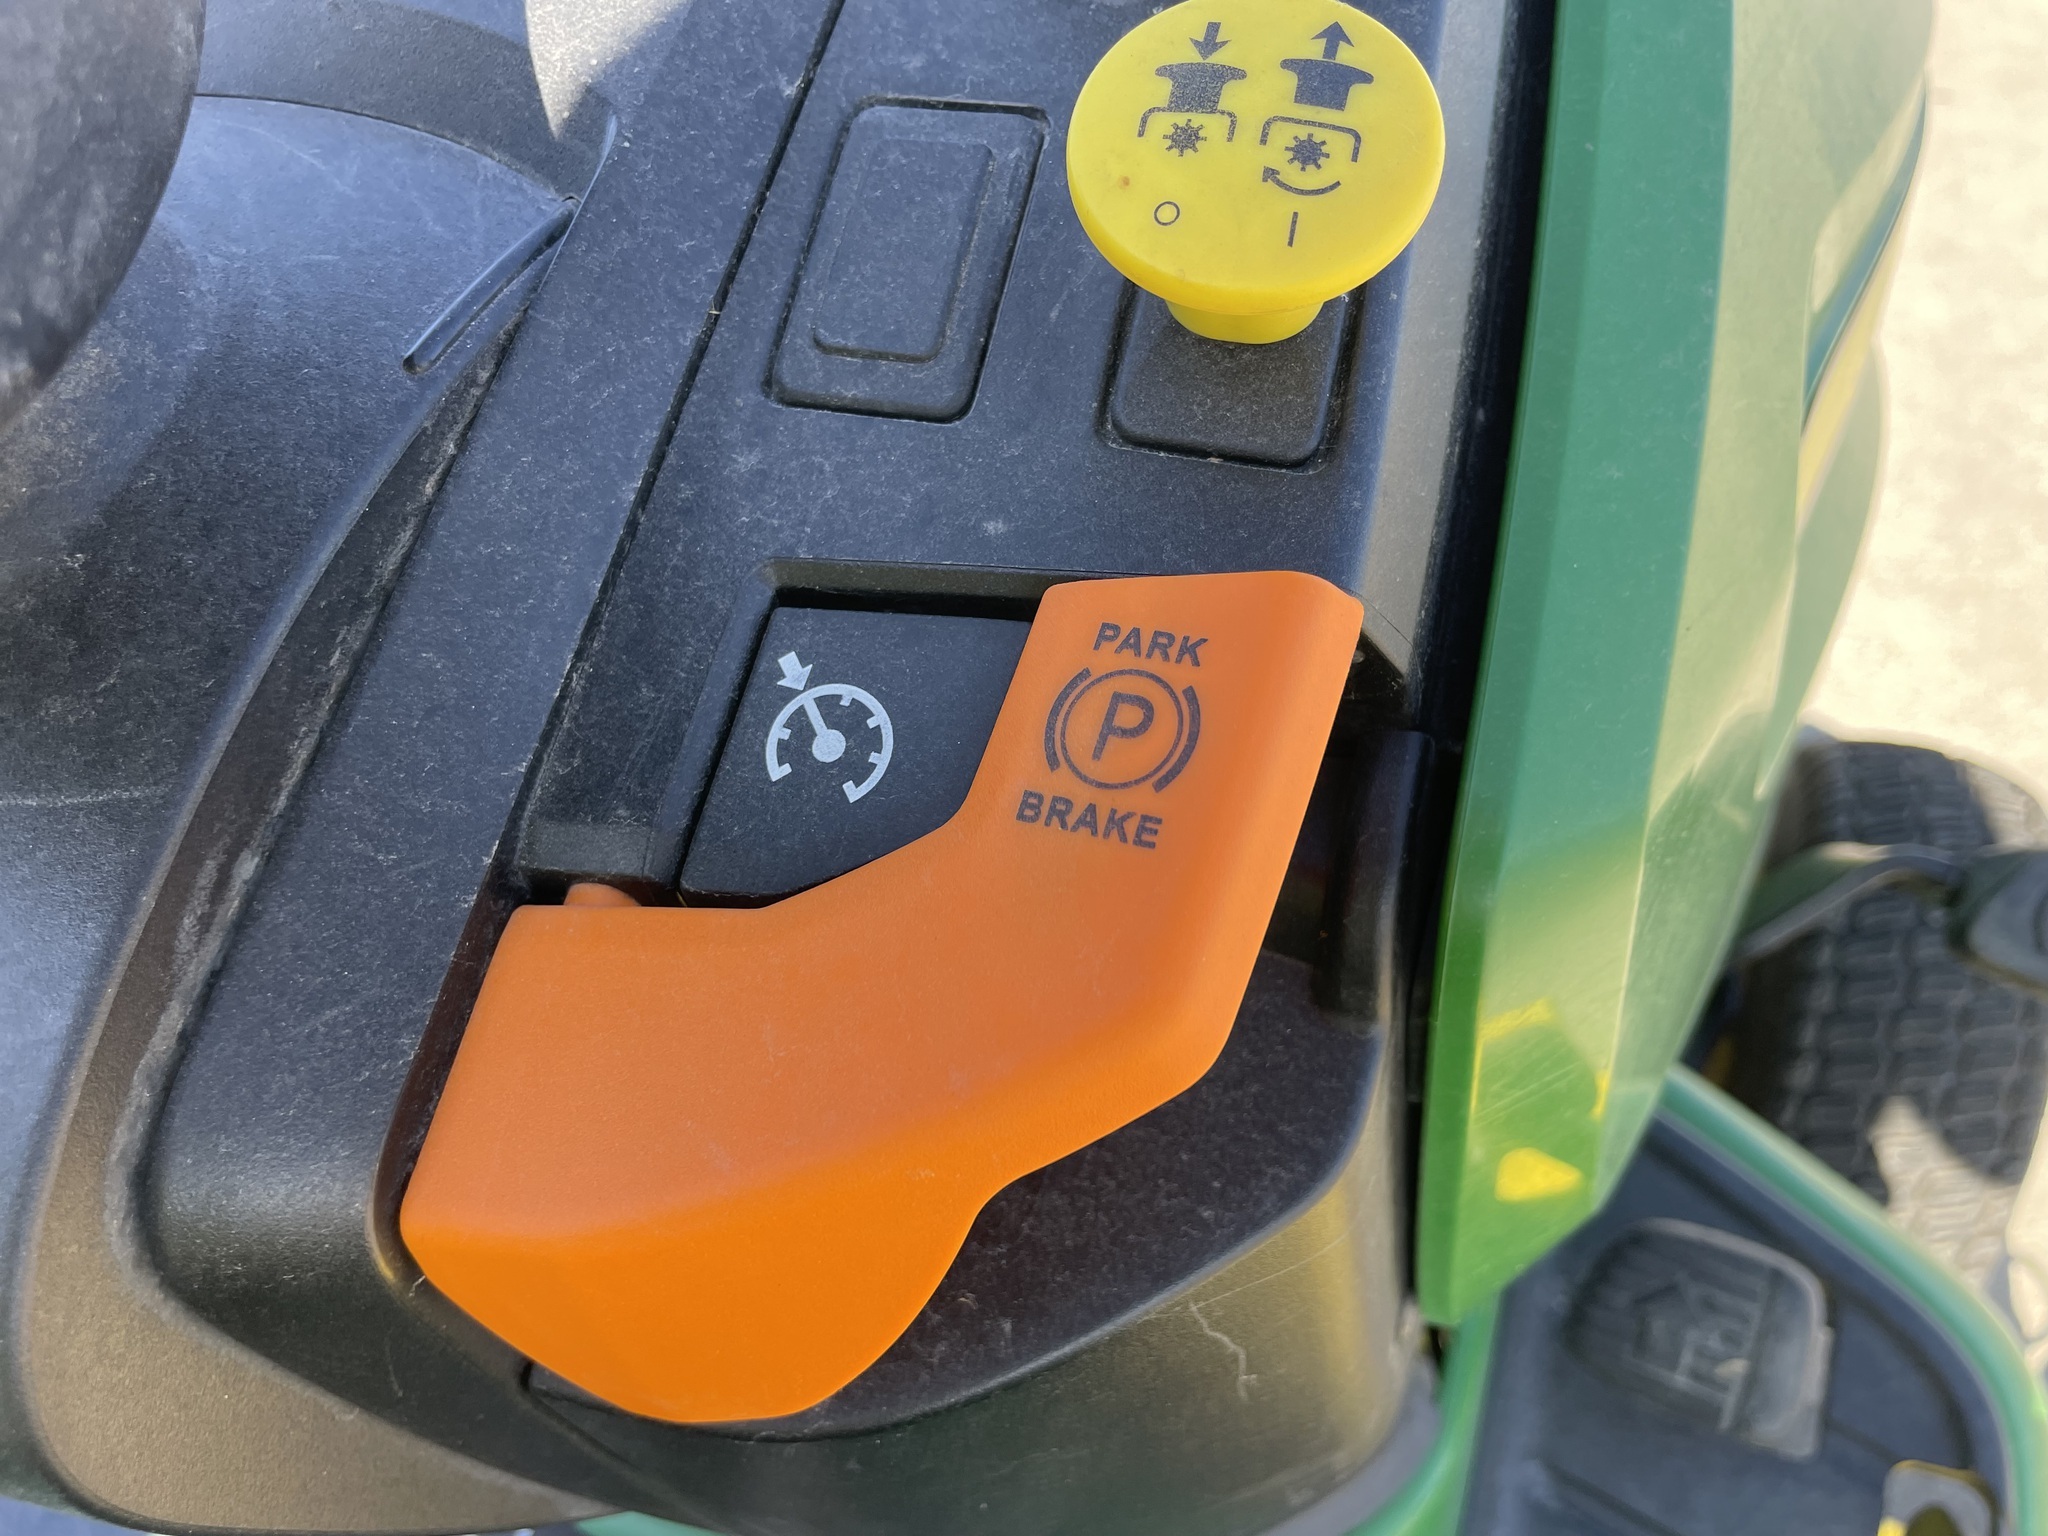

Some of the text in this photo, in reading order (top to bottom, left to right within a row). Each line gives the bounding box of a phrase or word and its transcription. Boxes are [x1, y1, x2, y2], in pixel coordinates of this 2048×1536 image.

[1093, 622, 1208, 667] PARK
[1091, 690, 1155, 762] P
[1015, 789, 1163, 849] BRAKE
